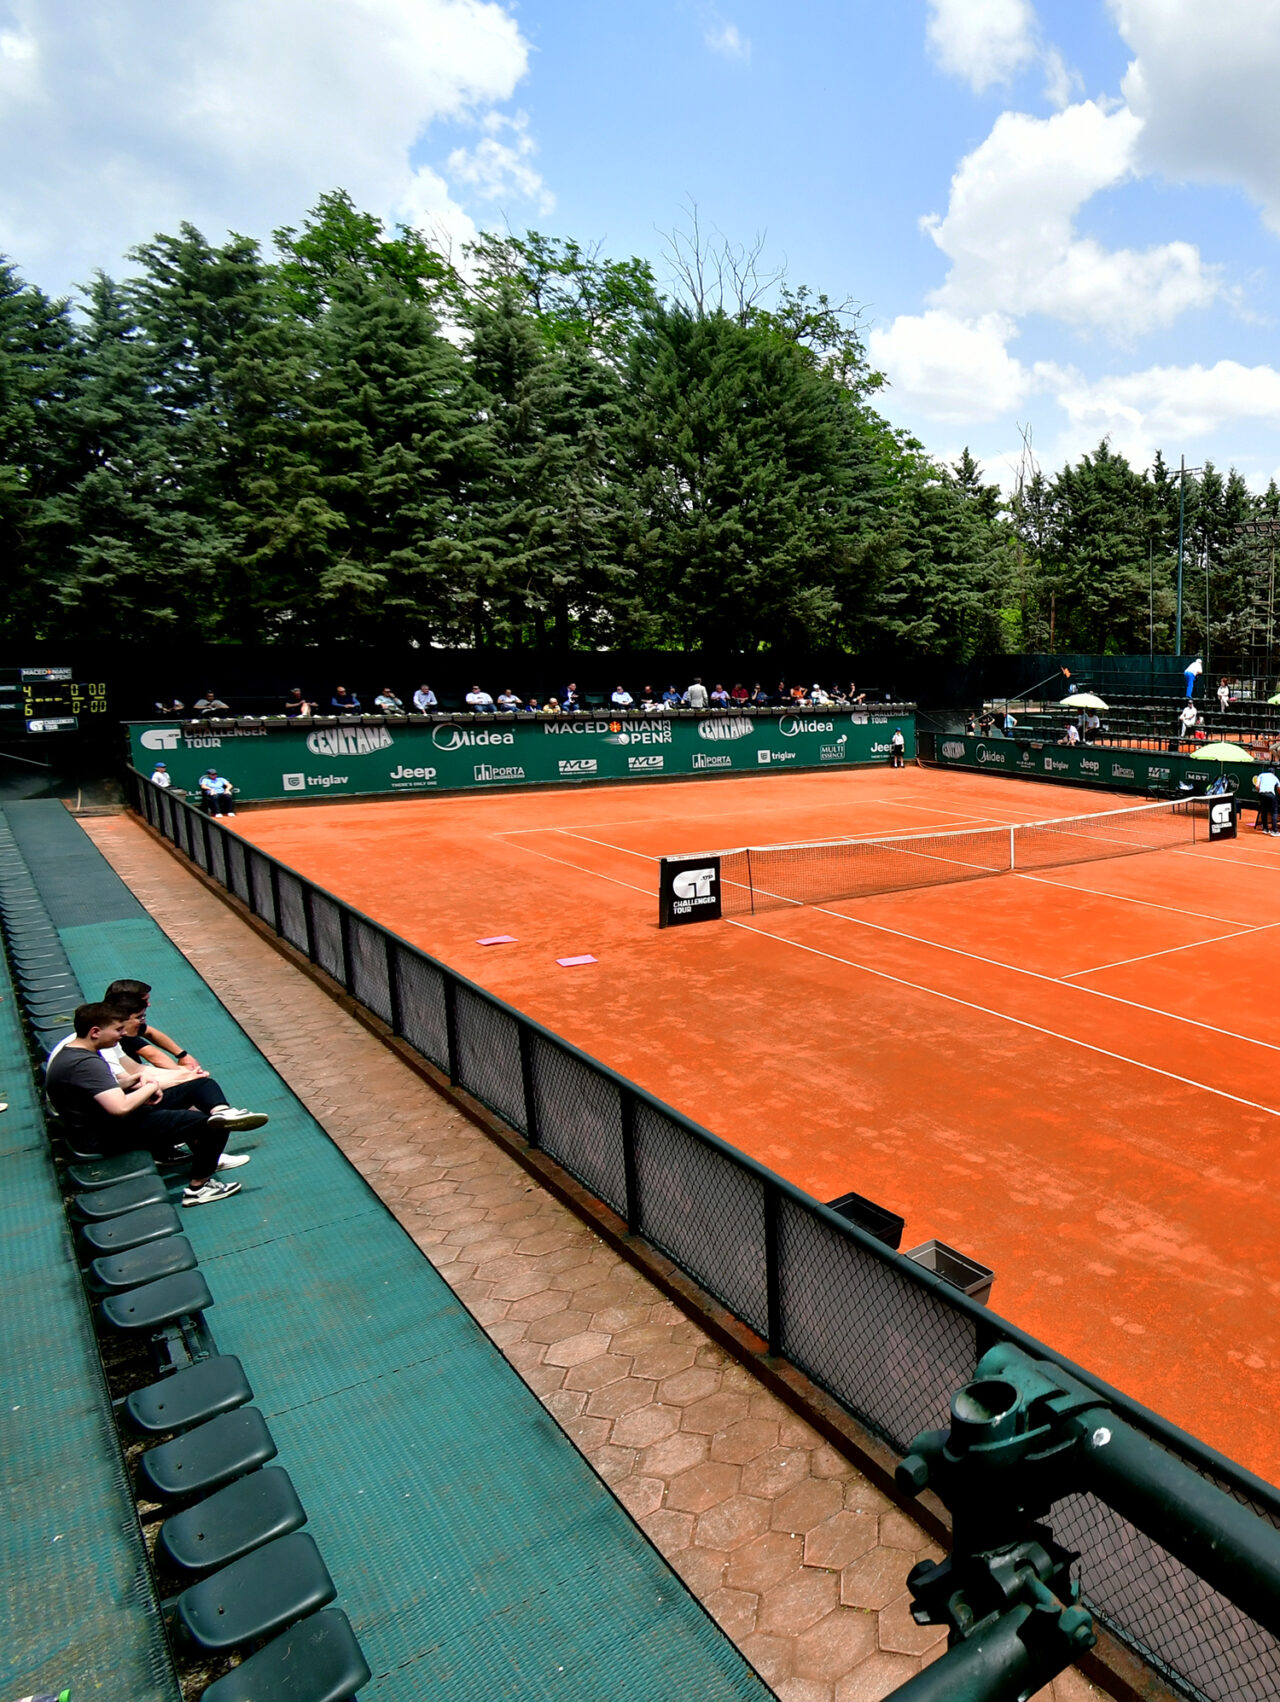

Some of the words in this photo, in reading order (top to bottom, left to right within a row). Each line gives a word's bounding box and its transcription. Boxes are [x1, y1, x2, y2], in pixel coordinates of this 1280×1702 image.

[23, 686, 31, 697] 4
[25, 704, 33, 716] 6
[788, 720, 833, 735] Midea
[185, 738, 221, 748] TOUR
[307, 726, 394, 757] CEVITANA
[445, 730, 514, 750] Midea
[821, 745, 844, 753] MULTI
[772, 752, 796, 761] triglav
[1080, 758, 1099, 771] Jeep
[390, 765, 436, 779] Jeep
[493, 767, 525, 775] PORTA
[307, 775, 349, 787] triglav
[673, 896, 716, 907] CHALLENGER
[673, 906, 692, 915] TOUR
